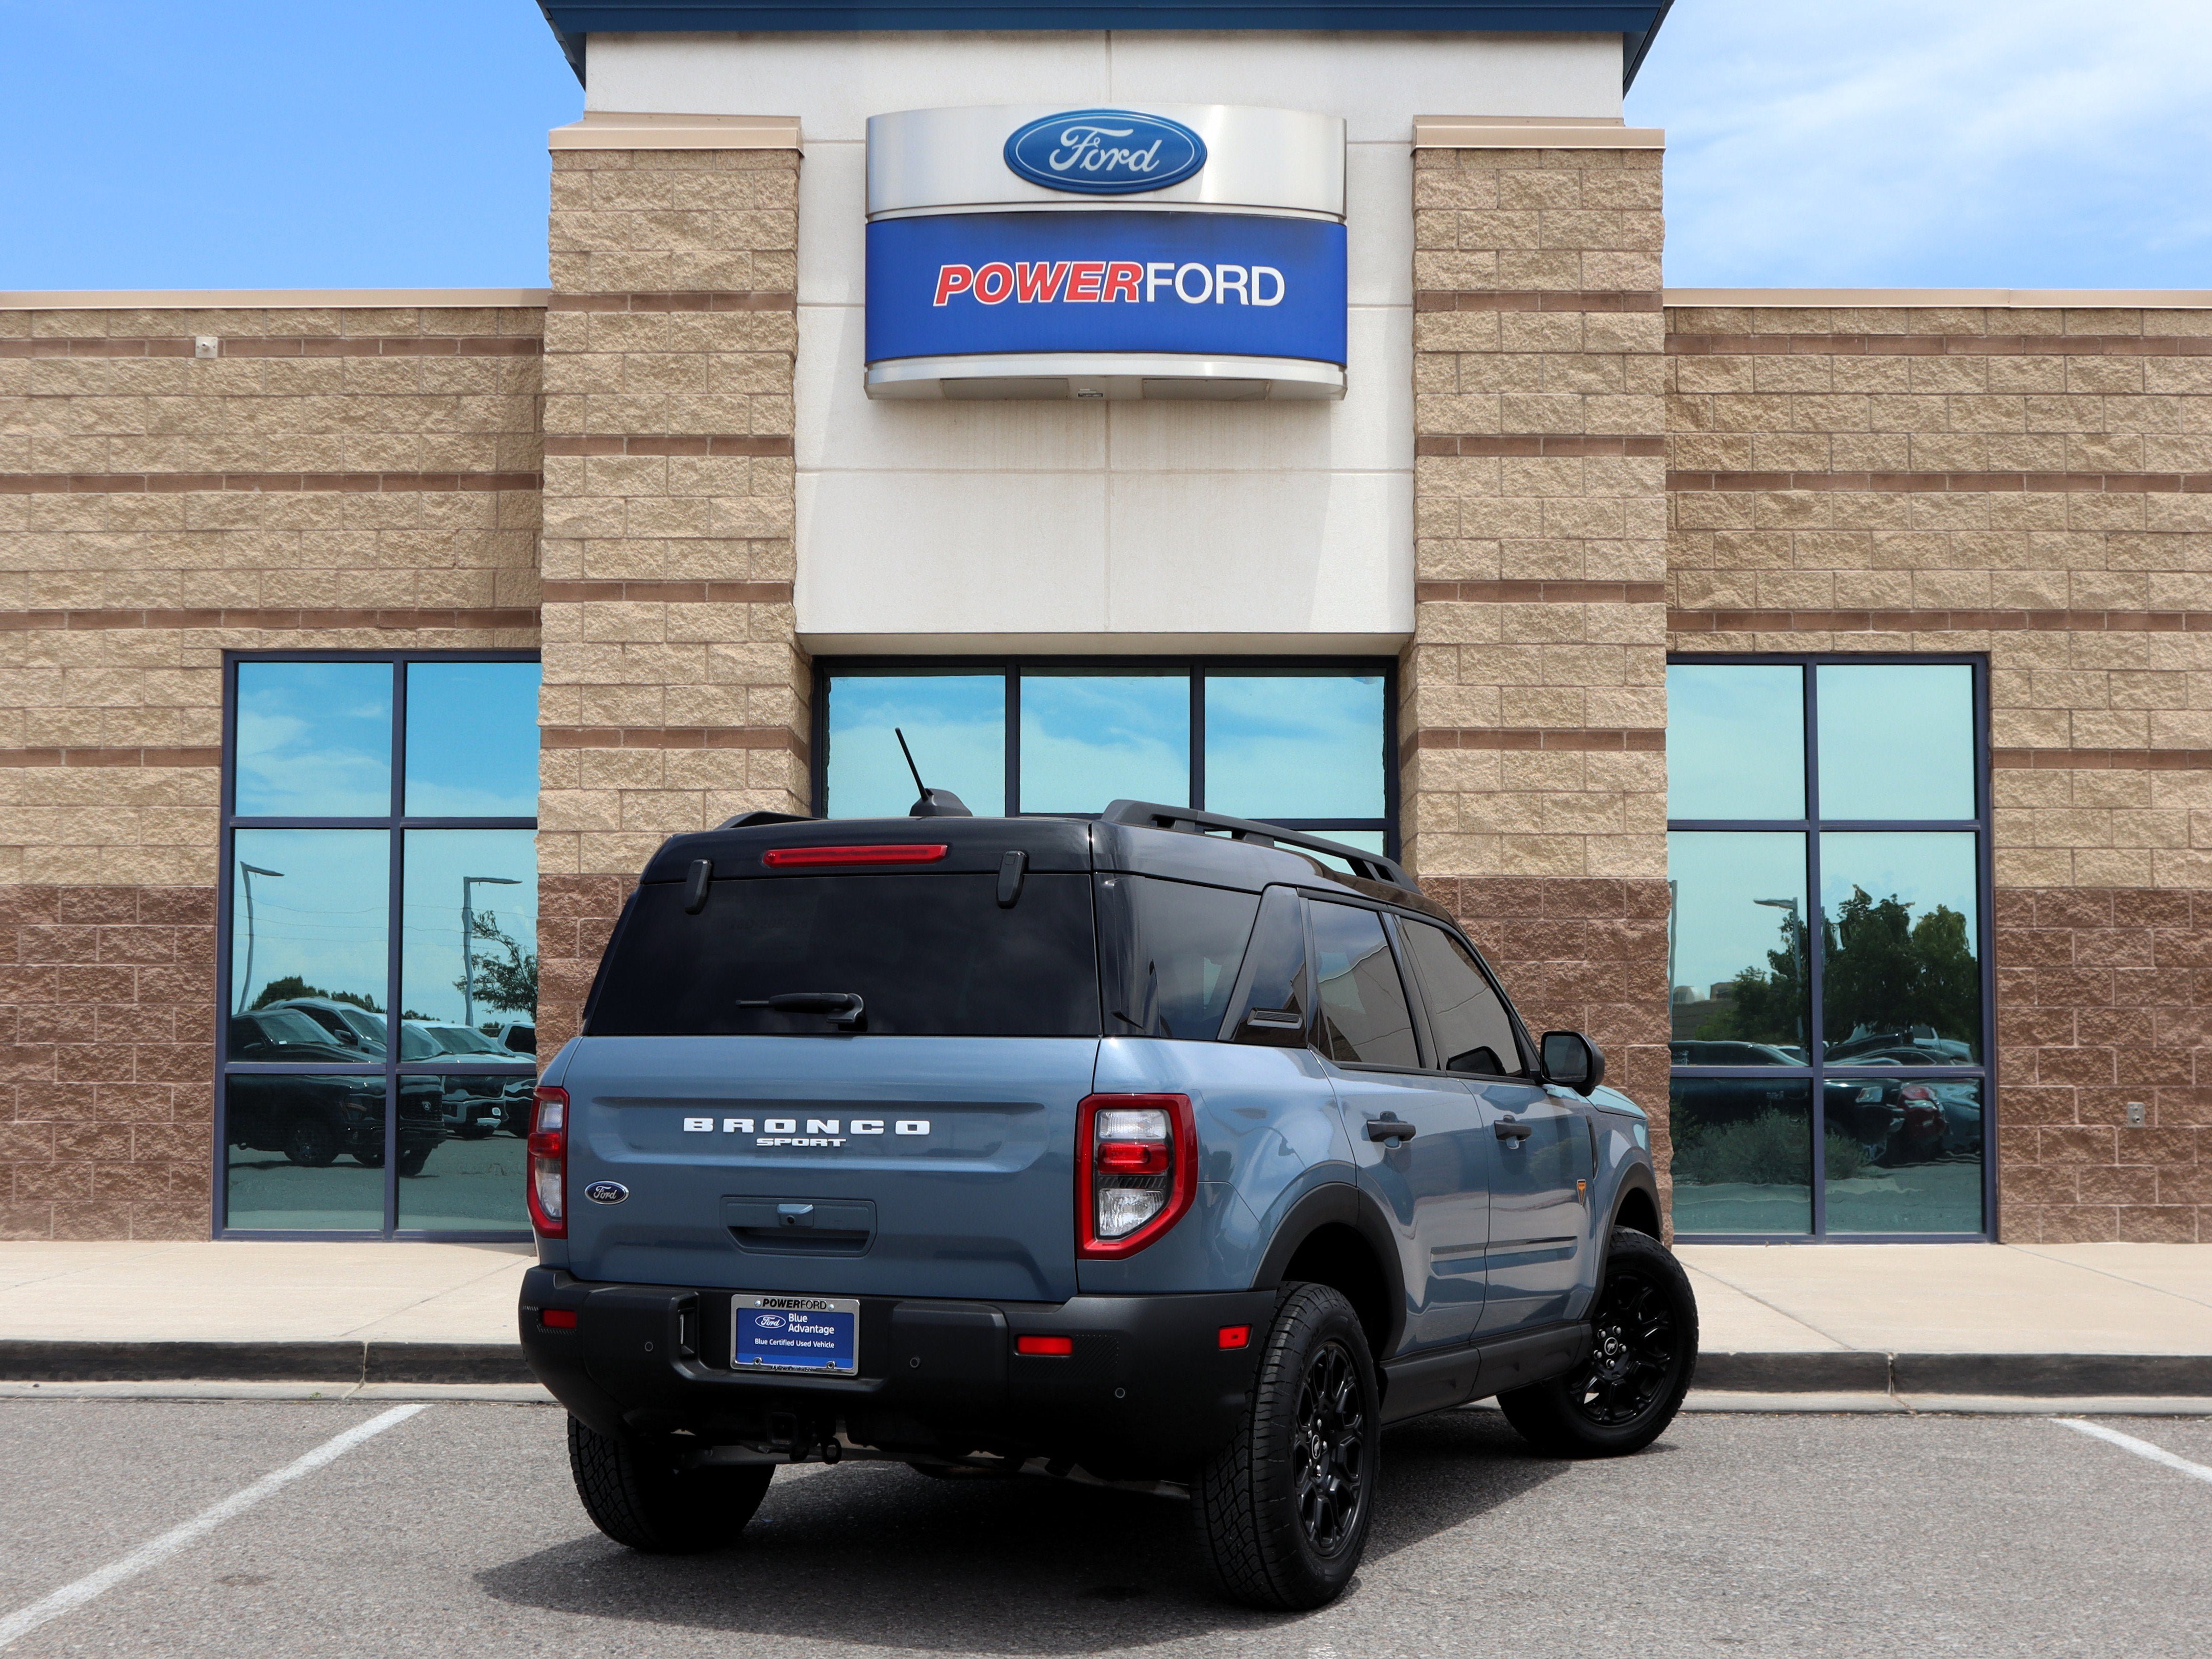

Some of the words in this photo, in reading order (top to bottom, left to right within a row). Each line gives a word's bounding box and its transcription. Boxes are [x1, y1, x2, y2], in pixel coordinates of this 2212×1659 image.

[1049, 126, 1161, 173] Ford
[933, 261, 1285, 307] POWERFORD
[683, 1118, 930, 1135] BRONCO
[756, 1138, 847, 1147] SPORT
[593, 1185, 617, 1199] Ford
[762, 1298, 827, 1310] POWERFORD
[760, 1317, 781, 1327] Ford
[788, 1313, 808, 1323] Blue
[788, 1324, 835, 1335] Advantage
[769, 1339, 794, 1347] Certified
